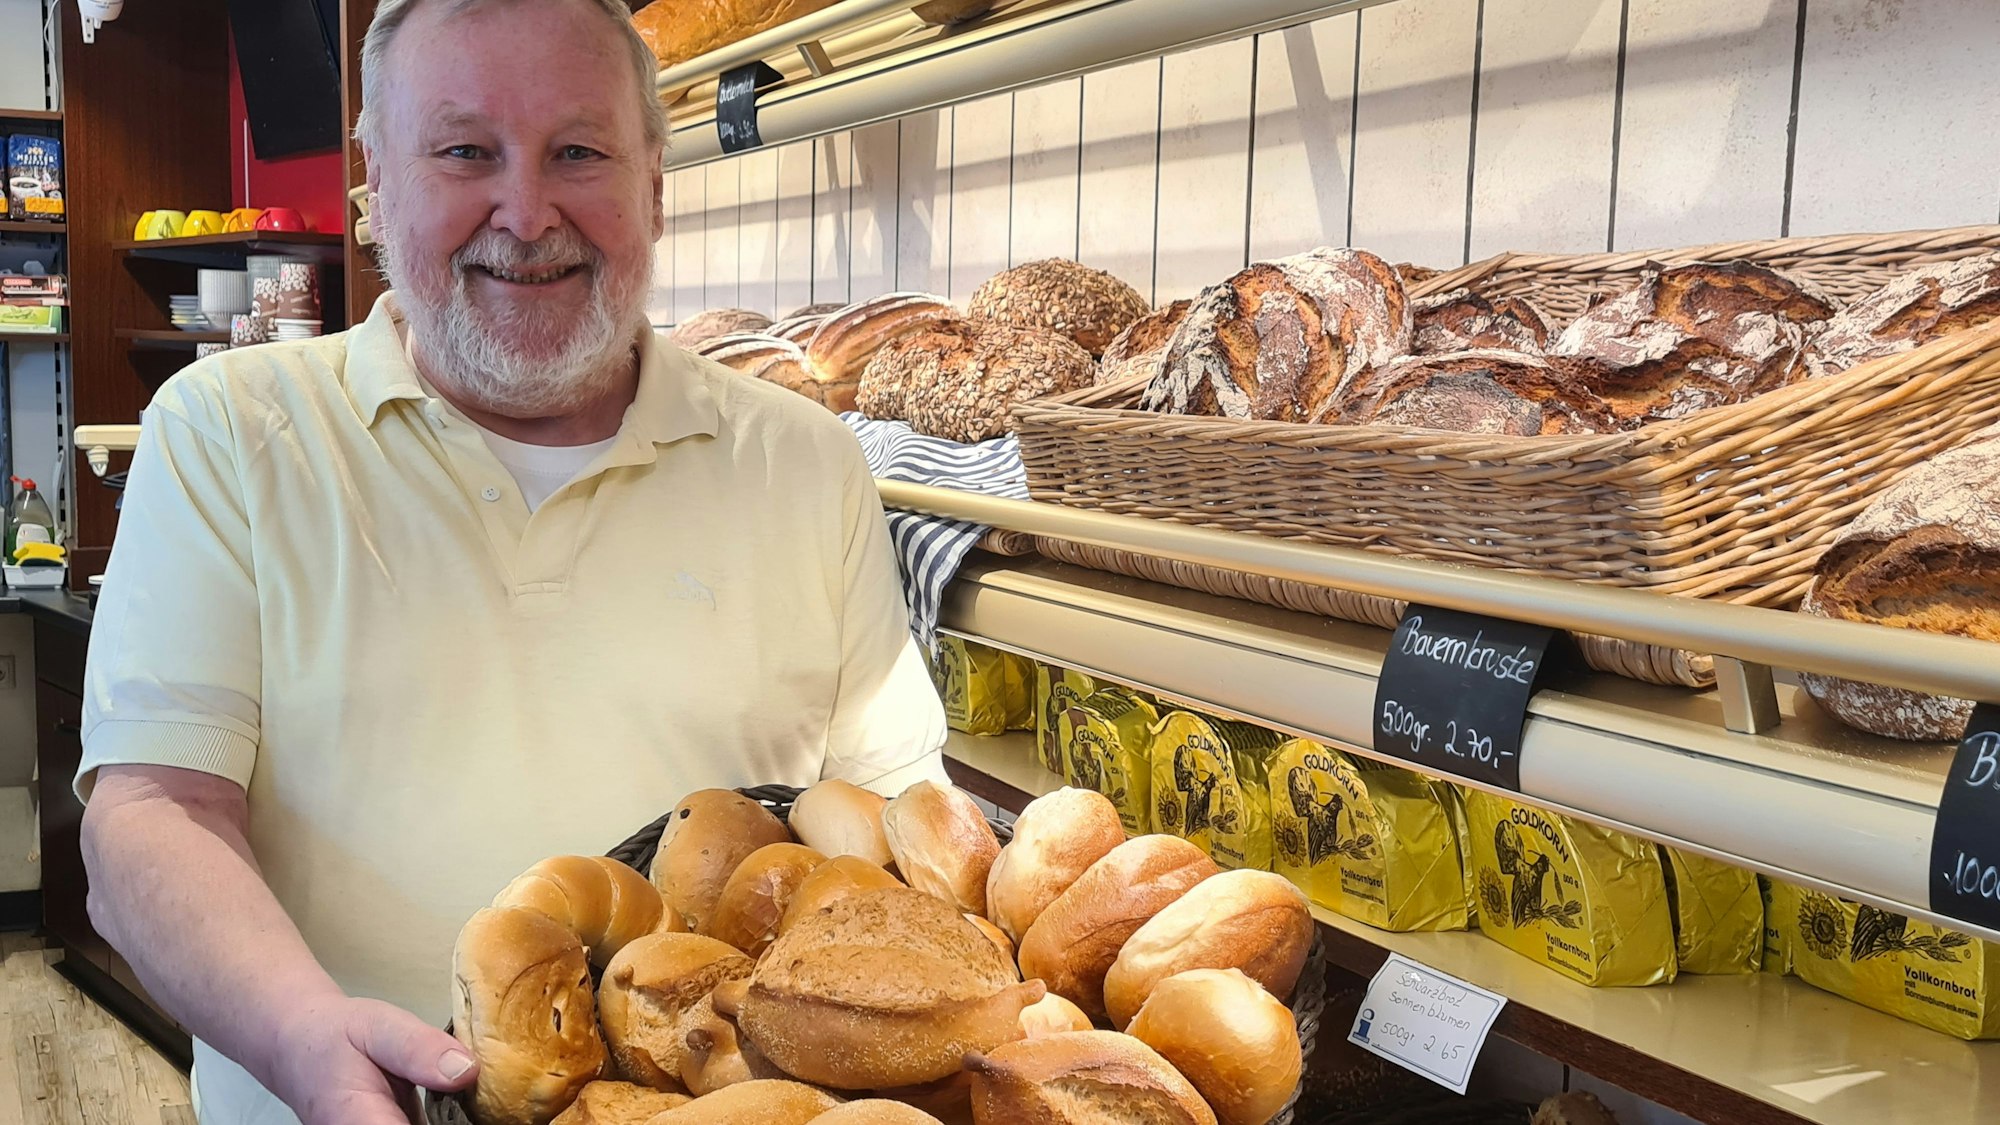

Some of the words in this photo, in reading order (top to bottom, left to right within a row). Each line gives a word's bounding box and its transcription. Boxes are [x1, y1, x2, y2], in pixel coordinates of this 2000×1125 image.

[1401, 615, 1534, 684] Bauernkruste
[1078, 730, 1115, 763] GOLDKORN
[1381, 700, 1431, 752] 500gr.
[1304, 754, 1359, 800] GOLDKORN
[1511, 808, 1569, 863] GOLDKORN
[1546, 932, 1591, 962] Vollkornbrot
[1904, 965, 1977, 1000] Vollkornbrot
